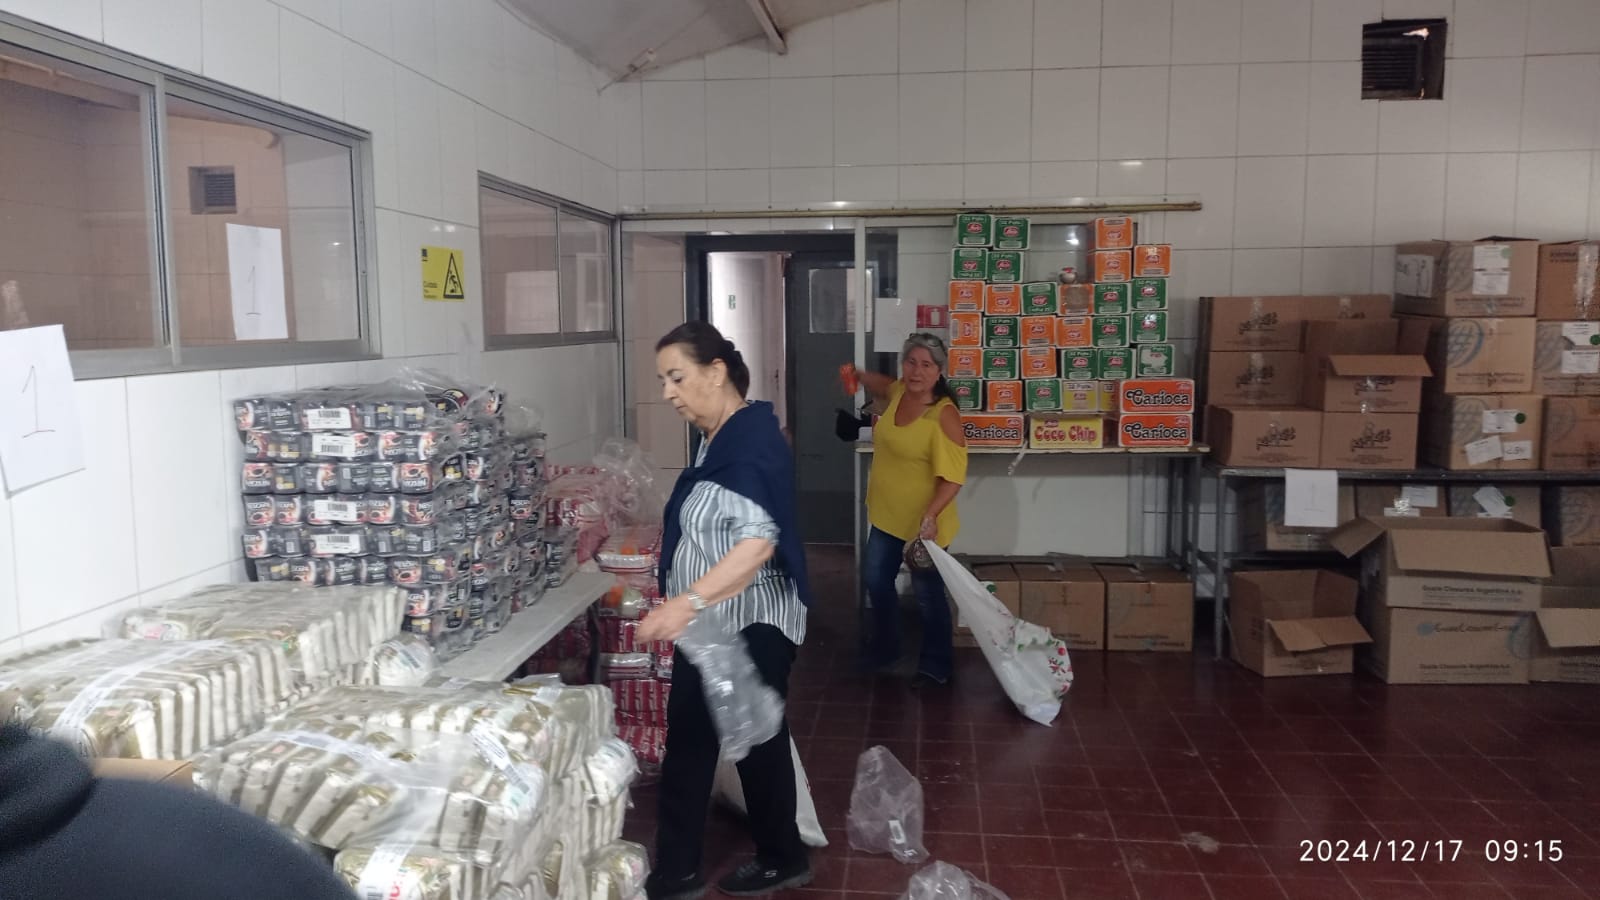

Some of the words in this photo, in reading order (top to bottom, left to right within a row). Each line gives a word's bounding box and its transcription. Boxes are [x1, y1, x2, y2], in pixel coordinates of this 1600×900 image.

[21, 364, 57, 439] 1
[1125, 388, 1190, 407] Carioca
[961, 423, 1019, 439] Carioca
[1034, 425, 1066, 442] Coco
[1068, 425, 1098, 443] Chip
[1124, 422, 1188, 440] Carioca
